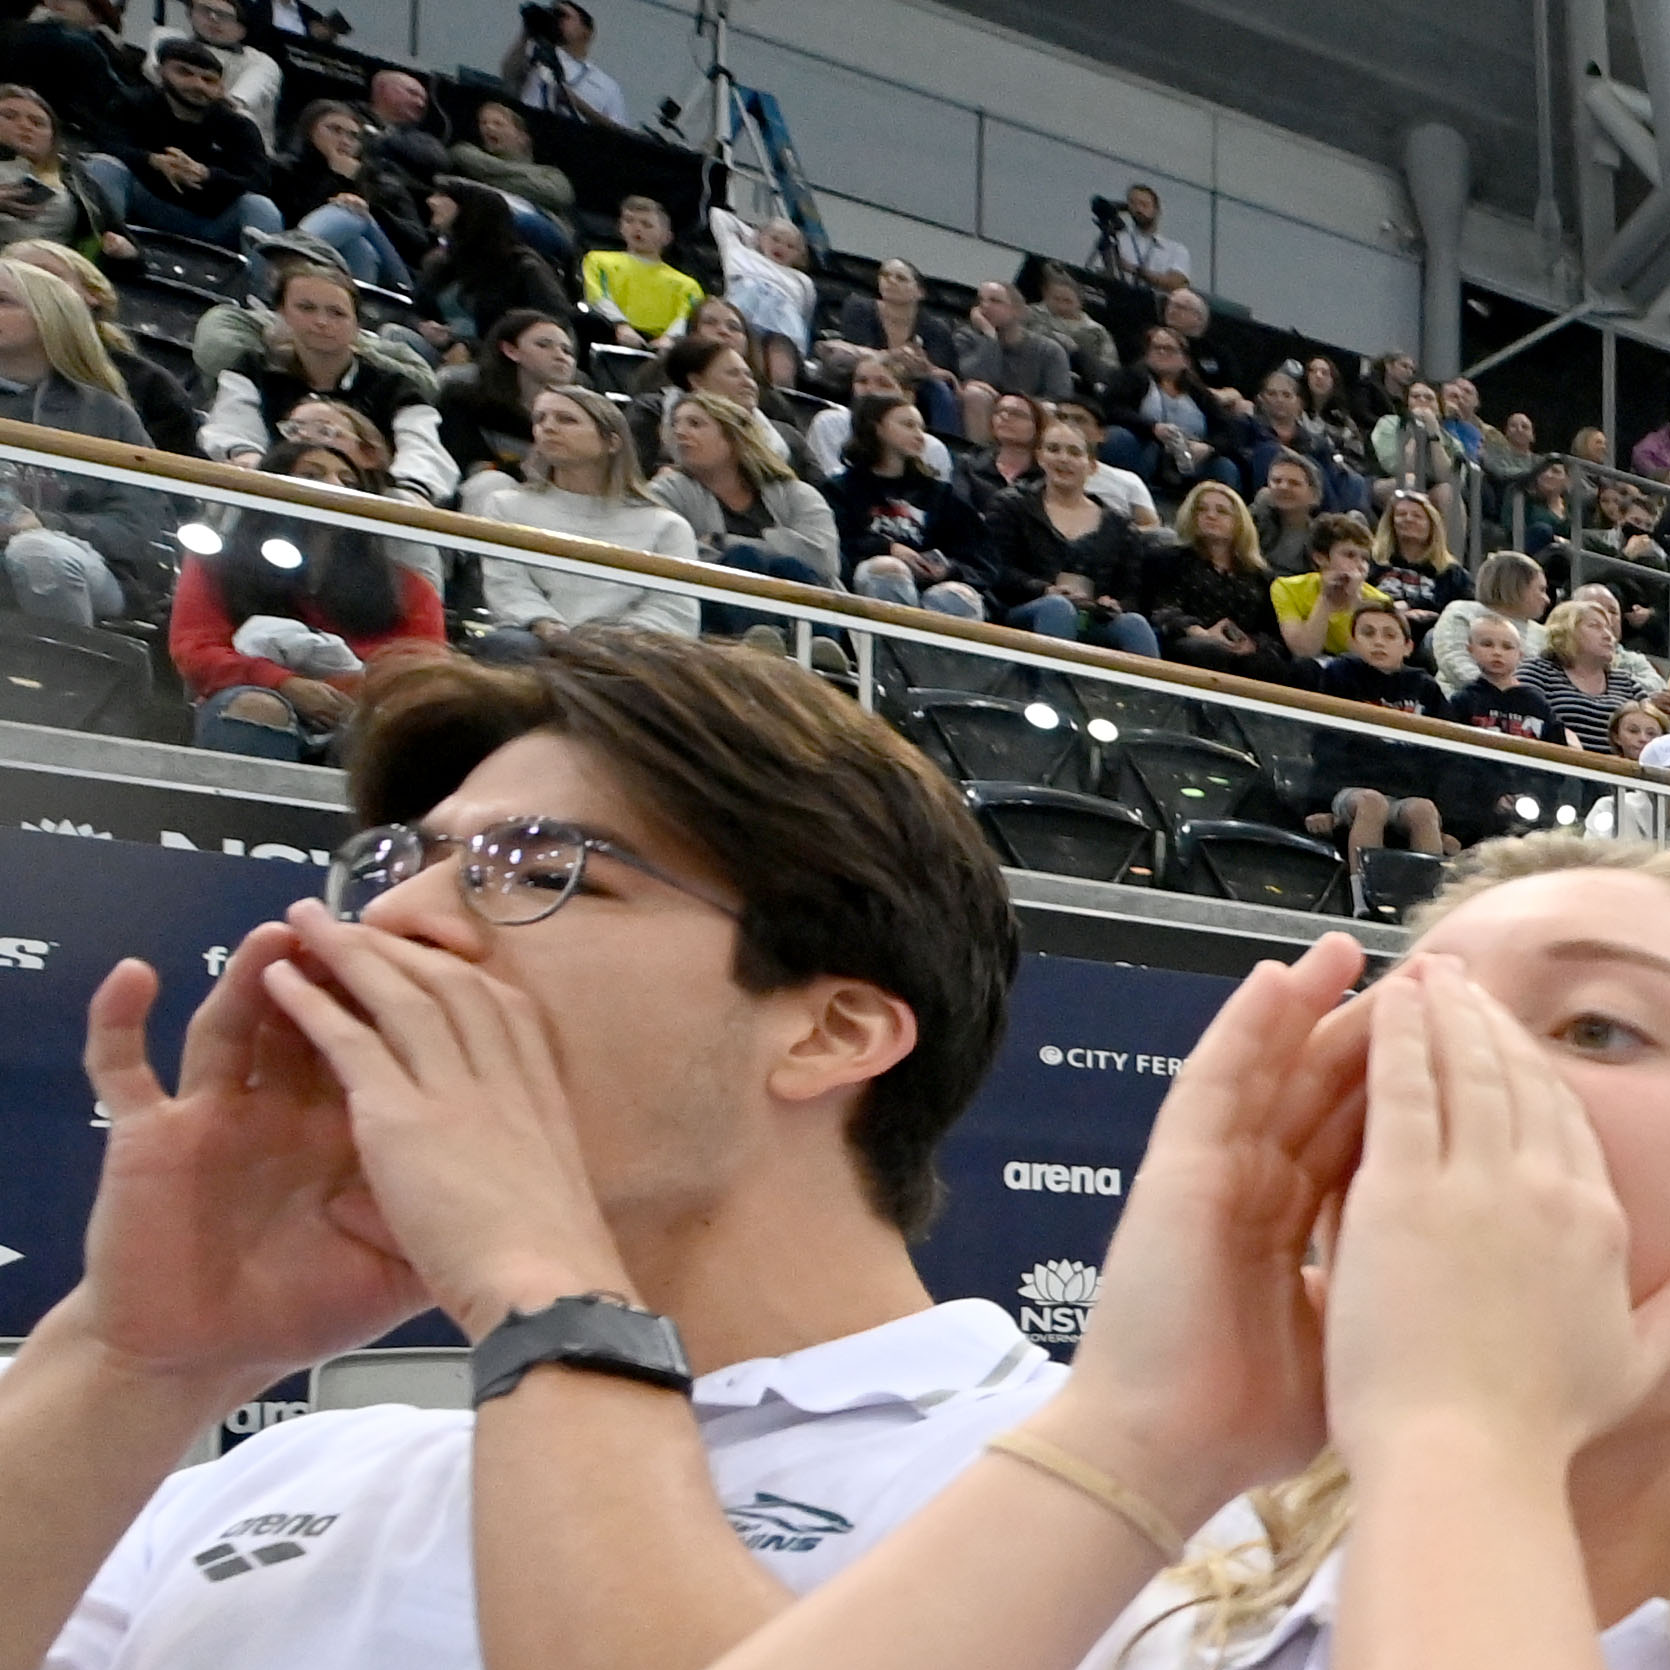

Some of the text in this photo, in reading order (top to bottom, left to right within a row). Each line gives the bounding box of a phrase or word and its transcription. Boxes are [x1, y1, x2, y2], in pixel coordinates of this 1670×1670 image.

[1067, 1048, 1190, 1076] CITY FER
[1003, 1161, 1121, 1195] arena
[219, 1513, 340, 1538] arena
